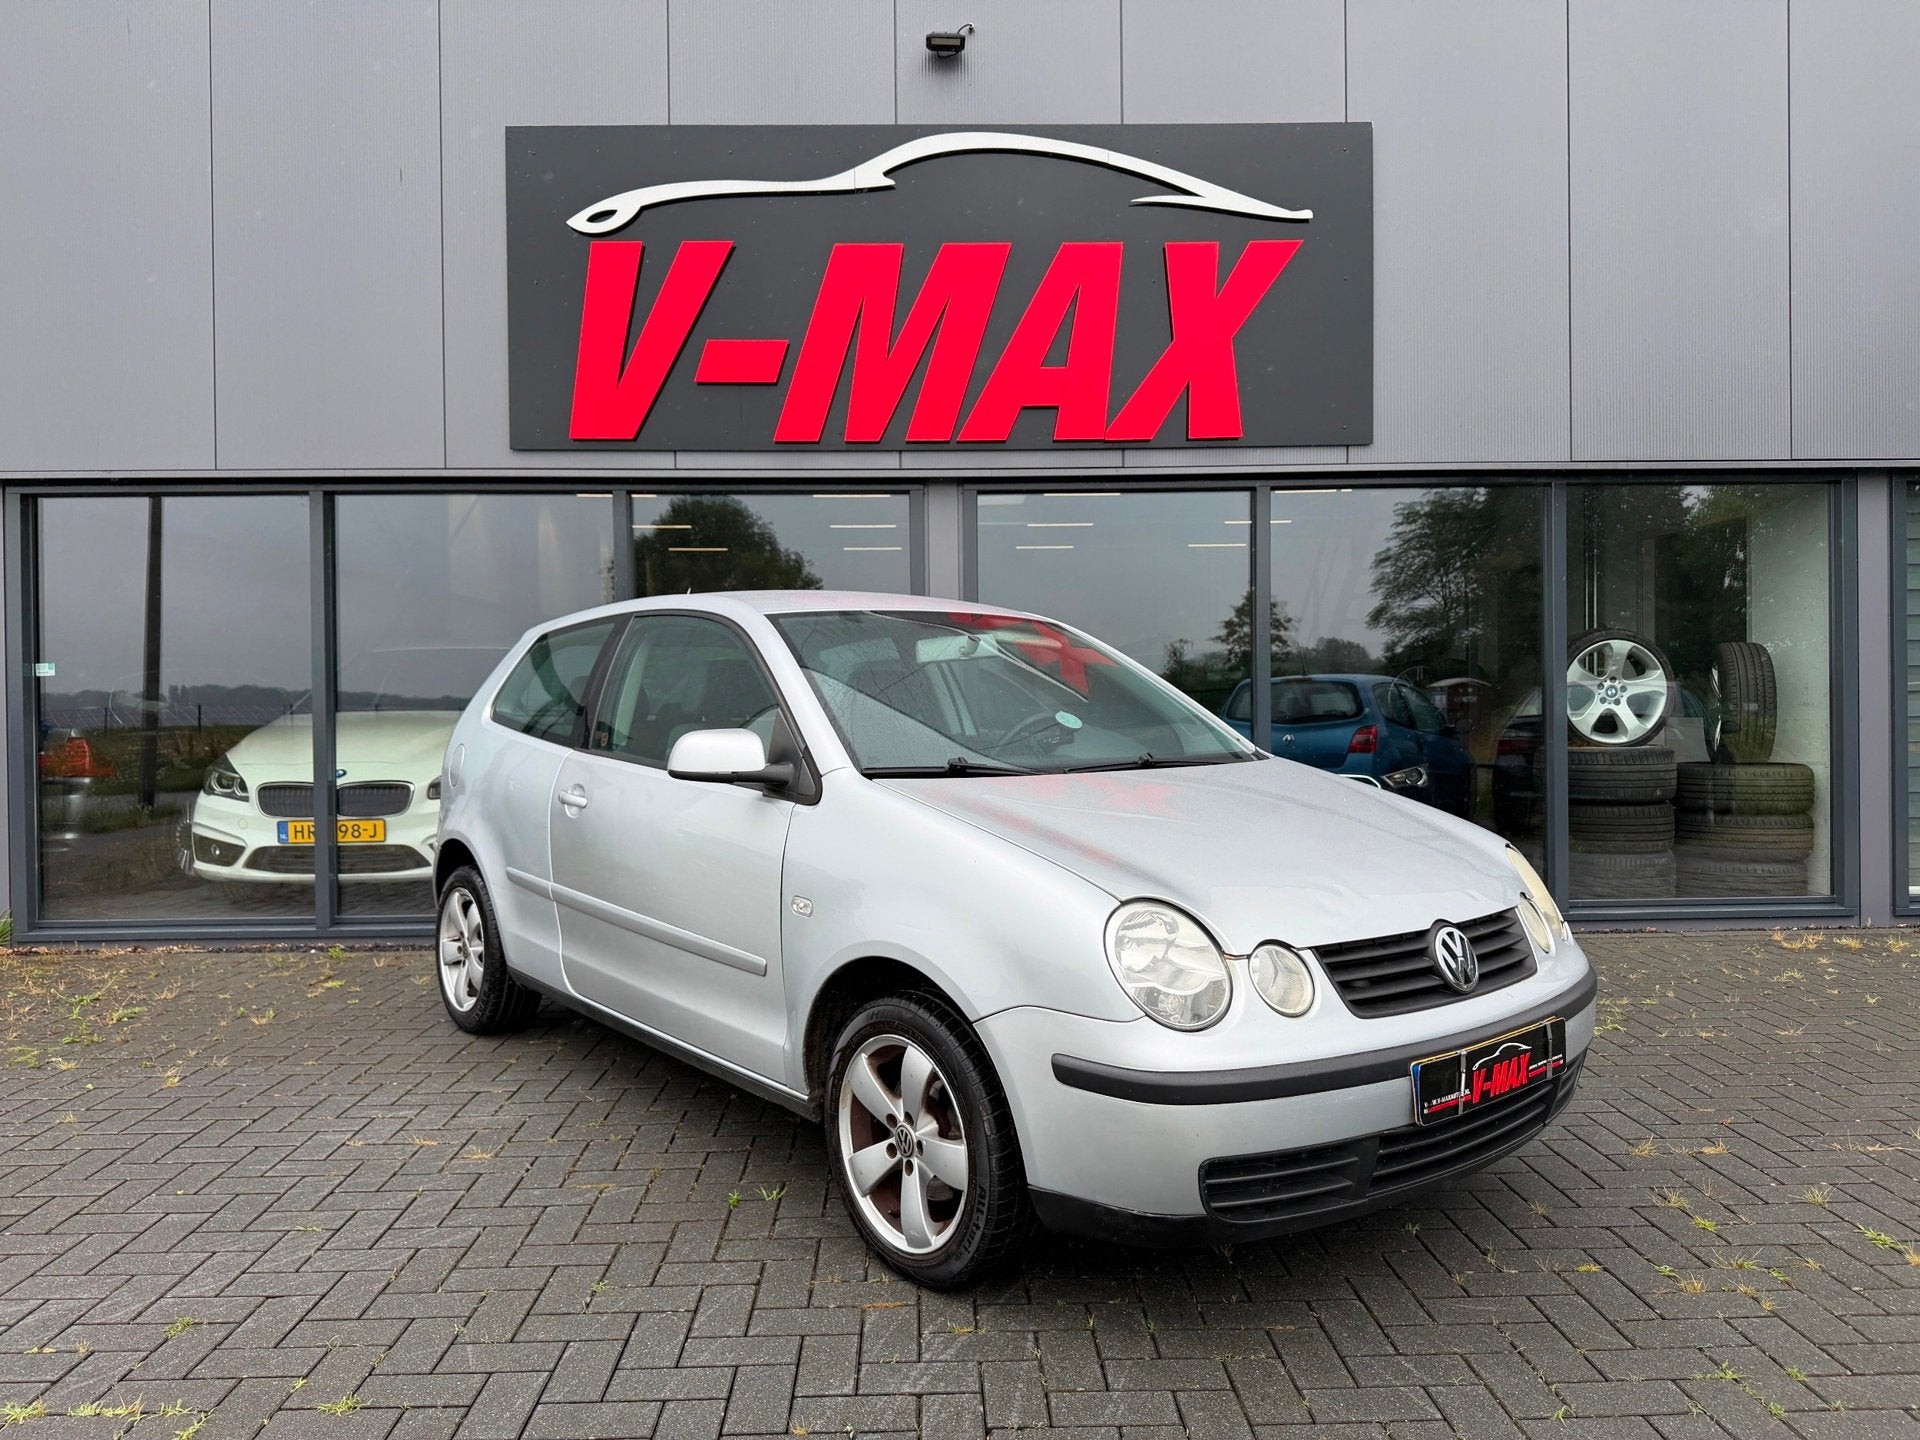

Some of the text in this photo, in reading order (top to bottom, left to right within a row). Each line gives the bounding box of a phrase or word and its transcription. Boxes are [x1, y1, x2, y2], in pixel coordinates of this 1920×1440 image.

[569, 240, 1304, 442] V-MAX
[294, 823, 377, 840] HR98-J
[1435, 926, 1478, 991] VW
[1473, 1052, 1531, 1104] V-MAX
[896, 1125, 914, 1157] VW
